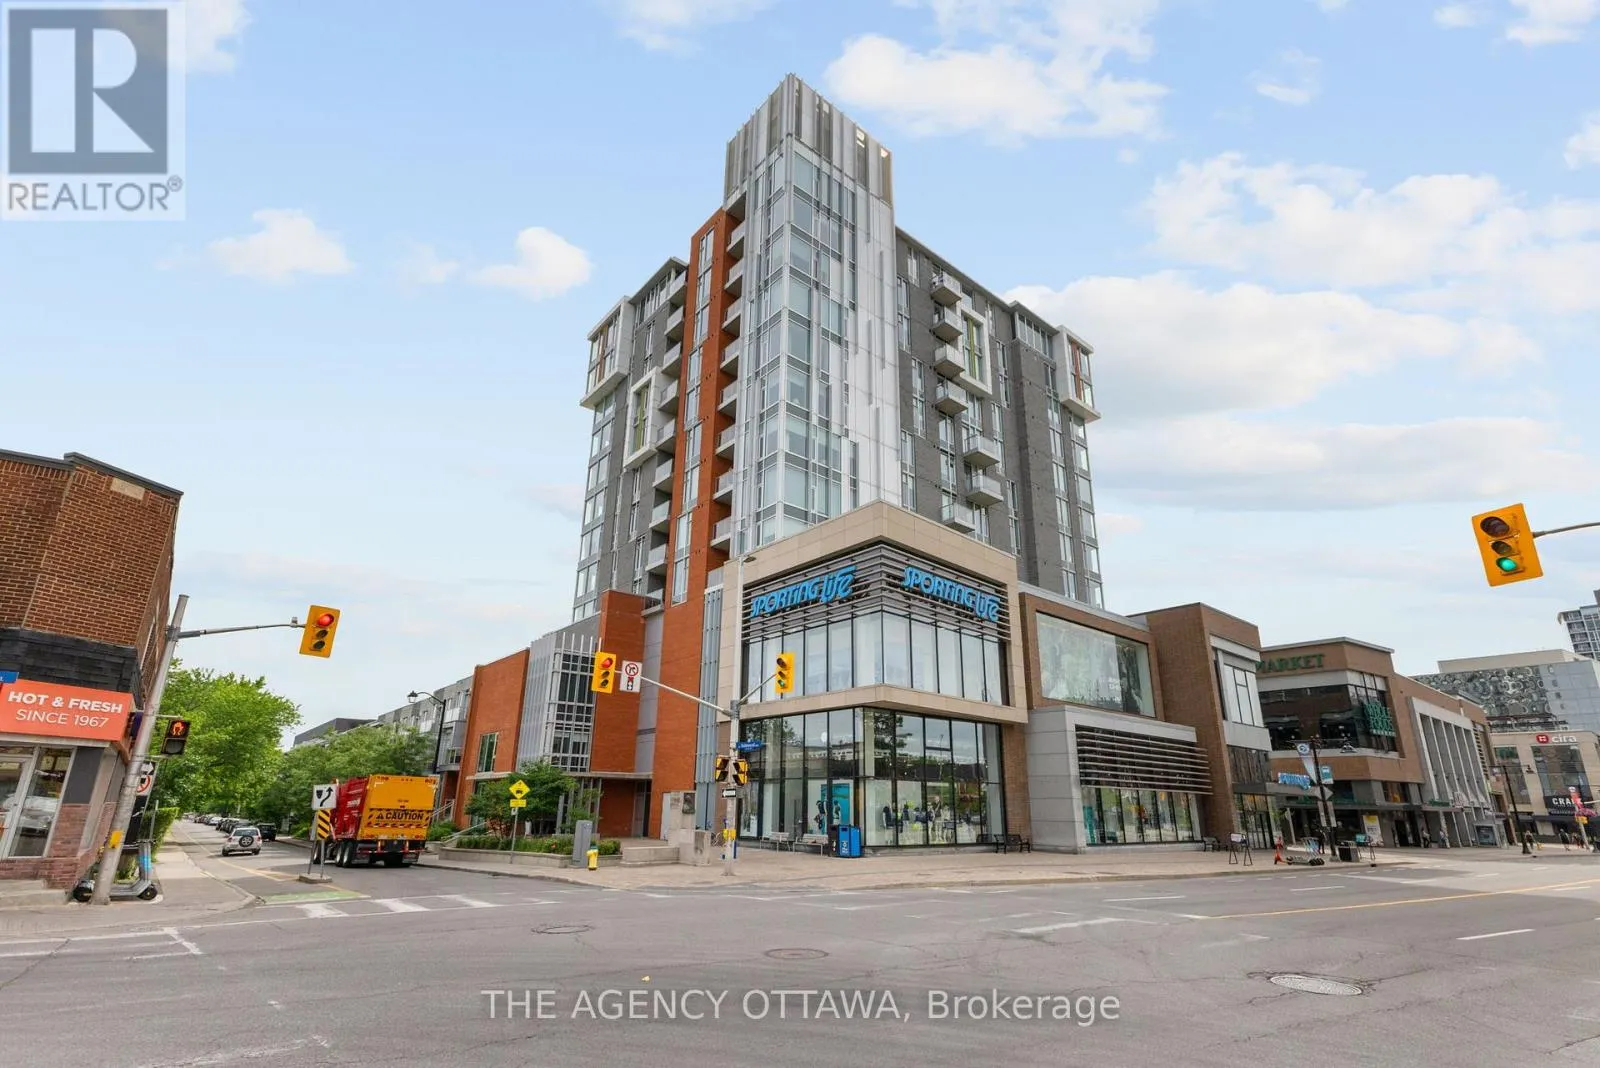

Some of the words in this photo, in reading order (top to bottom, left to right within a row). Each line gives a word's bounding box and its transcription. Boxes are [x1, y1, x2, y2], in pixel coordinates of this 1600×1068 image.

[8, 691, 49, 705] HOT
[51, 696, 65, 708] &
[68, 698, 123, 714] FRESH
[15, 709, 69, 724] SINCE
[74, 714, 109, 728] 1967
[385, 811, 424, 820] CAUTION
